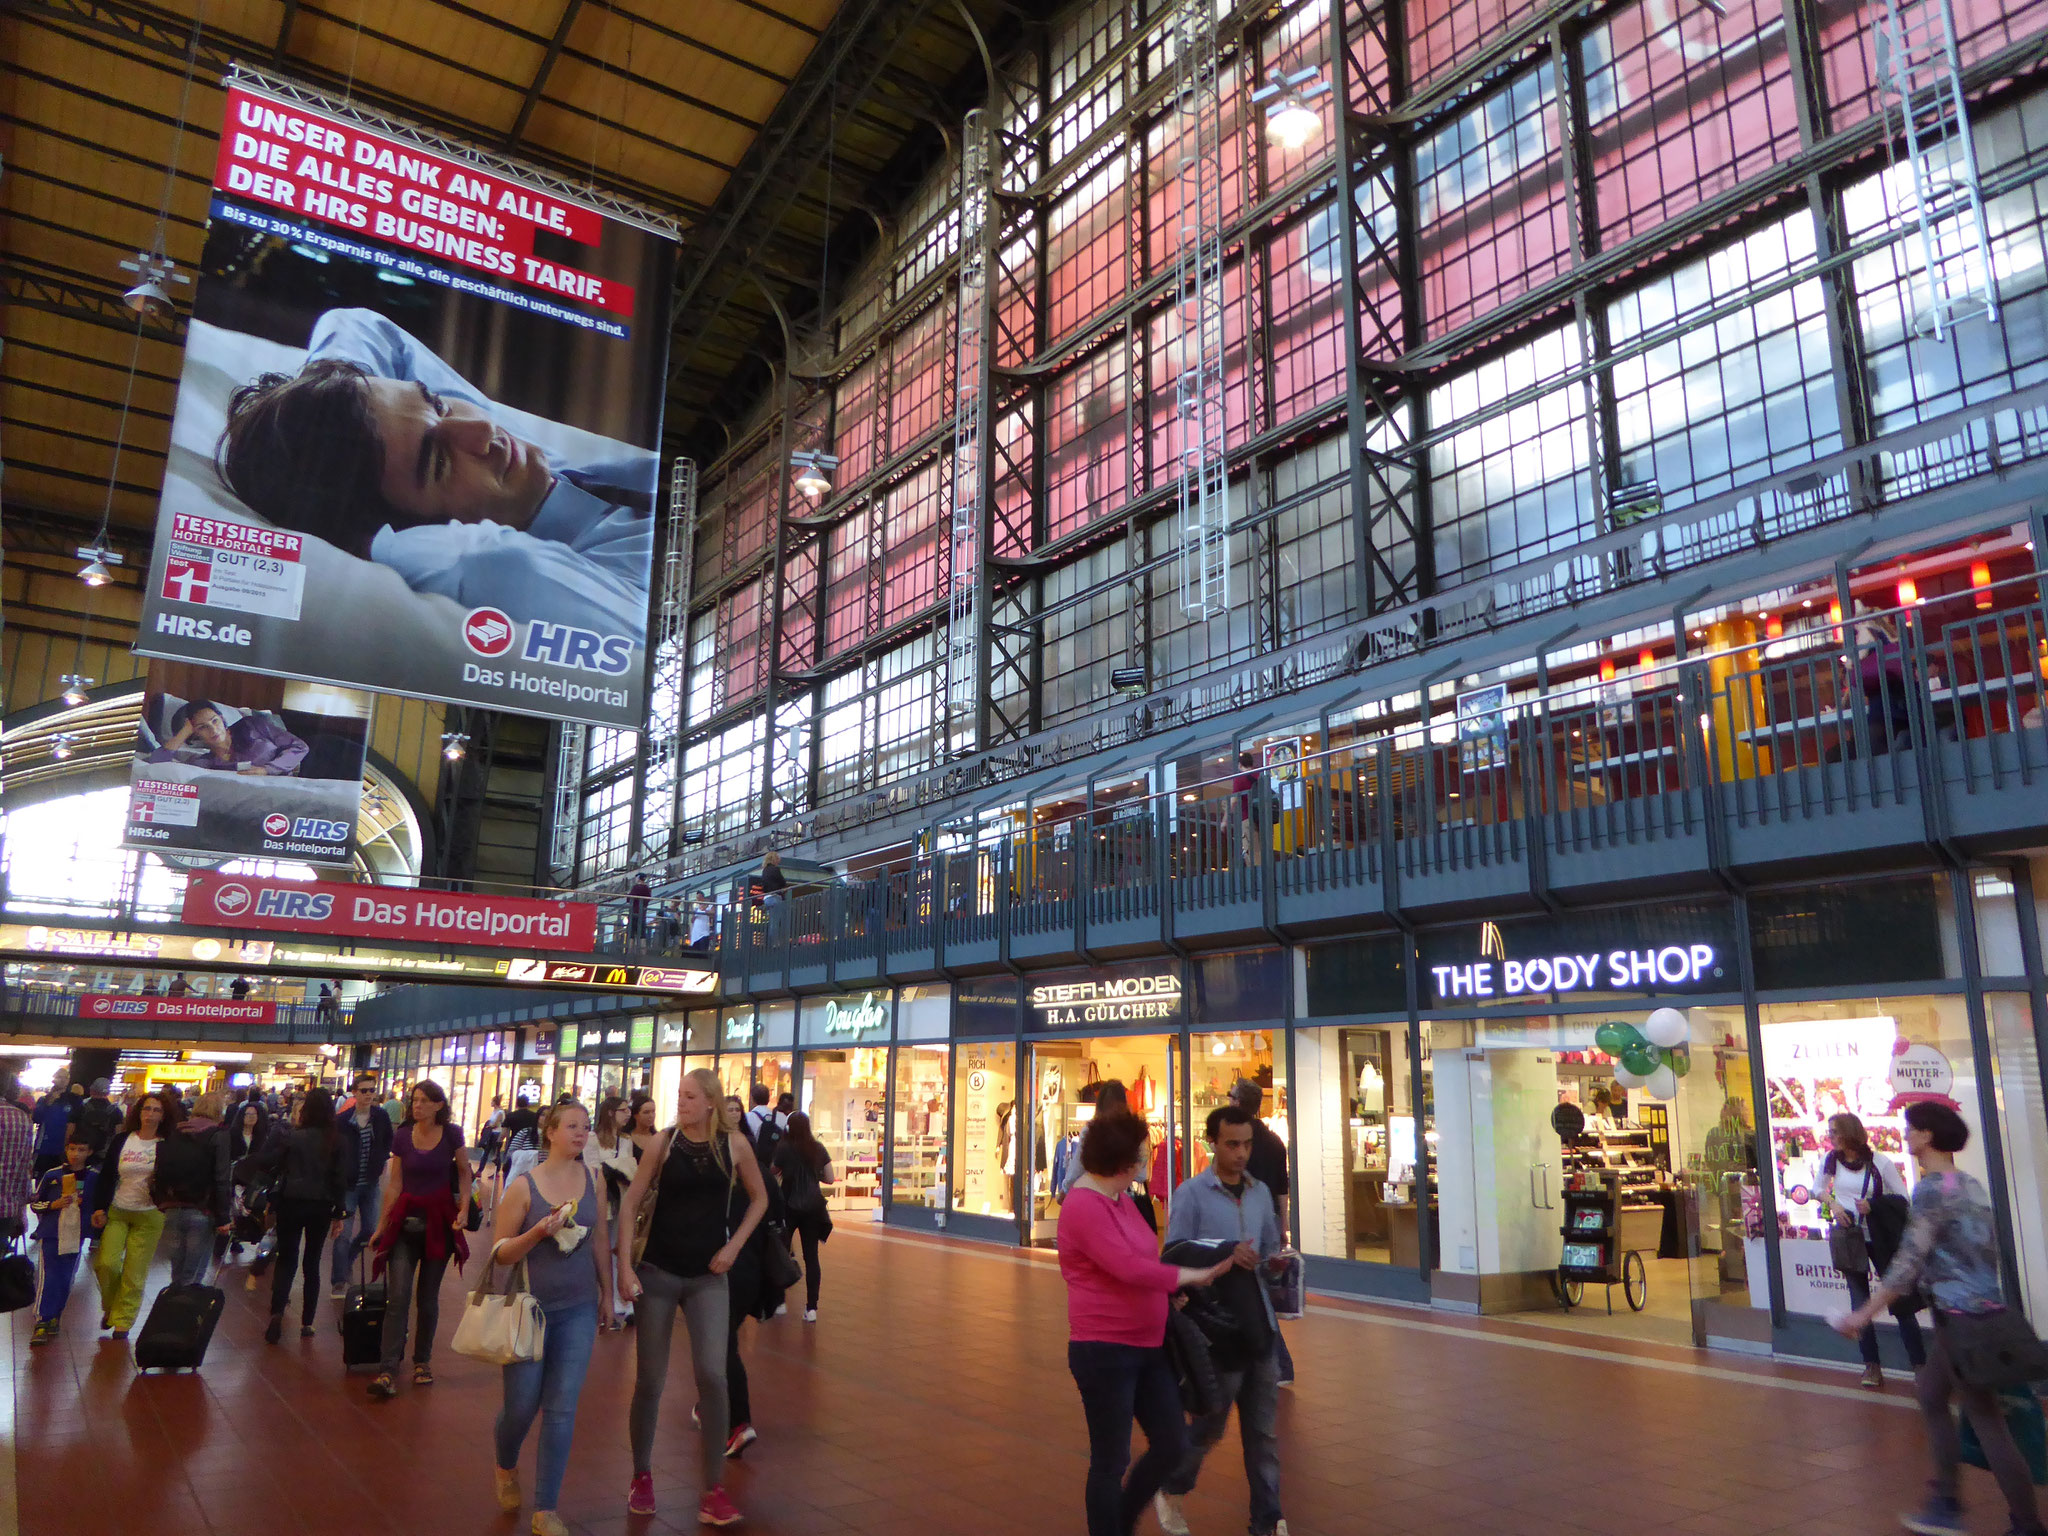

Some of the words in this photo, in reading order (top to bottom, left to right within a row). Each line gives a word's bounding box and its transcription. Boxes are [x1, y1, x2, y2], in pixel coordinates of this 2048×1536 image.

[239, 101, 345, 157] UNSER
[354, 140, 442, 188] DANK
[447, 174, 490, 205] AN
[497, 191, 572, 236] ALLE,
[233, 133, 290, 171] DIE
[296, 155, 393, 203] ALLES
[402, 189, 505, 241] GEBEN:
[229, 164, 295, 207] DER
[304, 189, 368, 228] HRS
[375, 211, 516, 275] BUSINESS
[523, 258, 605, 303] TARIF.
[223, 206, 246, 222] Bis
[249, 217, 267, 228] zu
[271, 221, 302, 239] 30%
[305, 231, 372, 259] Ersparnis
[374, 252, 396, 266] für
[398, 260, 426, 278] alle,
[429, 270, 450, 283] die
[452, 277, 528, 307] geschäftlich
[530, 301, 594, 327] unterwegs
[596, 321, 624, 337] sind.
[174, 530, 272, 556] HOTELPORTALE
[176, 514, 299, 551] TESTSIEGER
[170, 558, 189, 568] test
[217, 552, 249, 566] GUT
[253, 558, 284, 576] (2,3)
[156, 613, 251, 646] HRS.de
[521, 620, 635, 676] HRS
[463, 663, 504, 686] Das
[510, 671, 628, 707] Hotelportal
[137, 788, 183, 796] HOTELPORTALE
[138, 780, 197, 792] TESTSIEGER
[128, 827, 169, 839] HRS.de
[292, 817, 350, 841] HRS
[264, 839, 284, 850] Das
[286, 841, 346, 856] Hotelportal
[254, 889, 335, 920] HRS
[353, 897, 406, 925] Das
[416, 902, 571, 937] Hotelportal
[1432, 962, 1493, 997] THE
[1504, 953, 1600, 993] BODY
[1609, 944, 1713, 987] SHOP
[1033, 974, 1181, 1003] STEFFI-MODEN
[112, 1001, 148, 1014] HRS
[157, 1002, 183, 1015] Das
[187, 1003, 263, 1018] Hotelportal
[1084, 1002, 1169, 1021] GÜLCHER
[1896, 1068, 1944, 1078] MUTTER-
[1910, 1078, 1932, 1088] TAG
